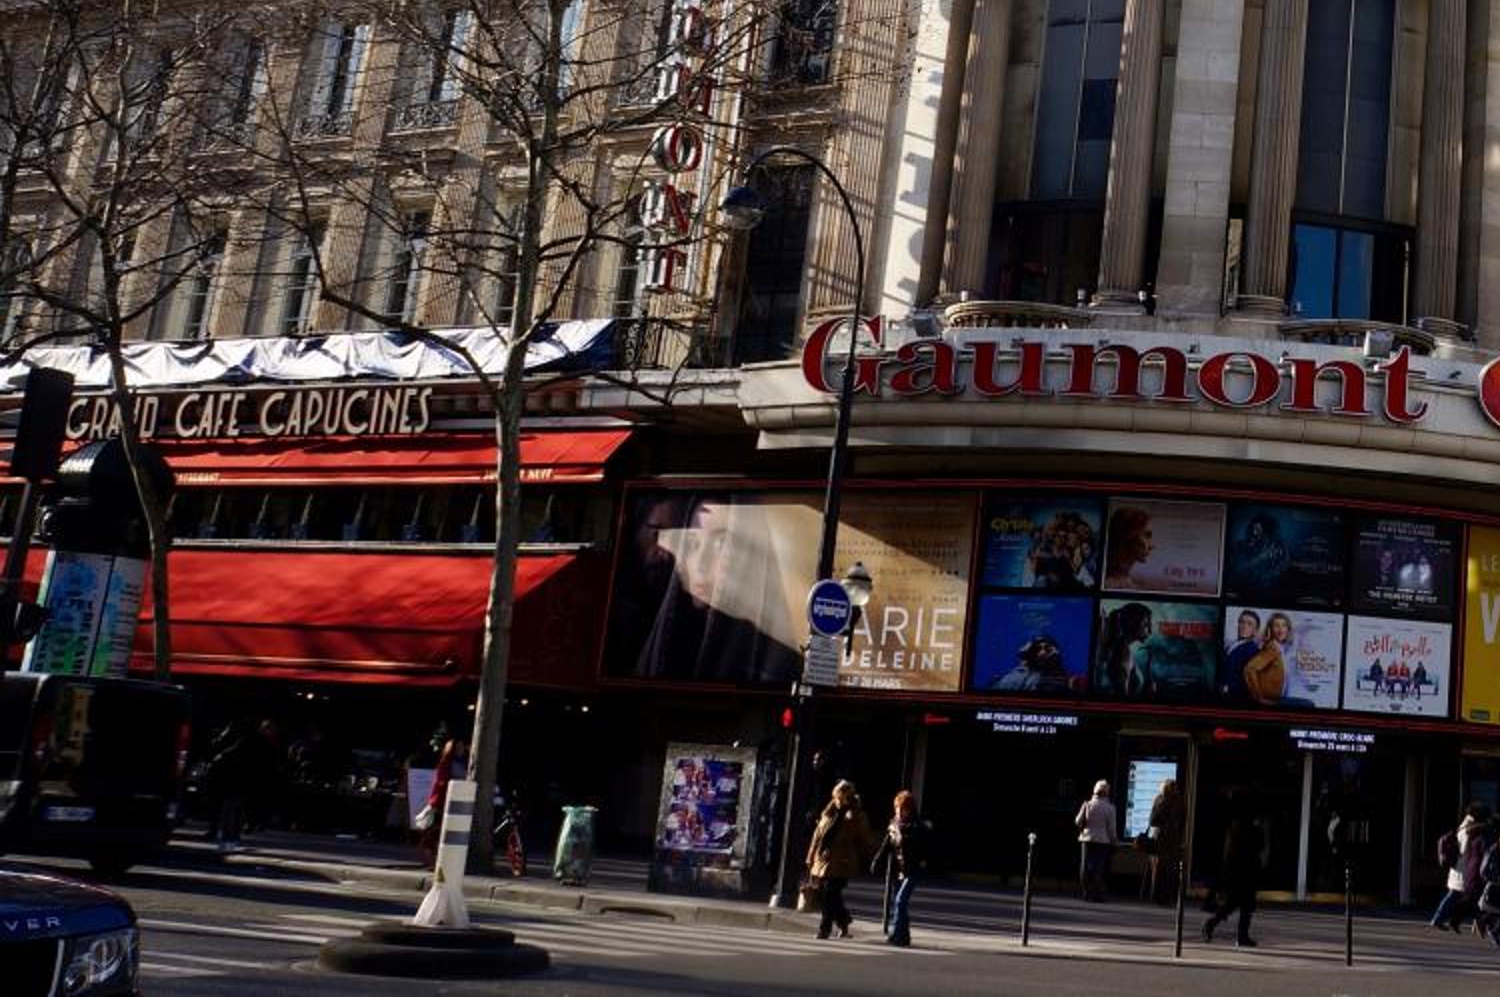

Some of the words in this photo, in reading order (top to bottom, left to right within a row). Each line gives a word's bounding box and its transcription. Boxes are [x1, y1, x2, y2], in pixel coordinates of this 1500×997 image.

[801, 314, 1428, 424] Gaumont
[259, 387, 433, 436] CAPUCINES
[842, 605, 959, 648] ARIE
[841, 650, 954, 671] DELEINE
